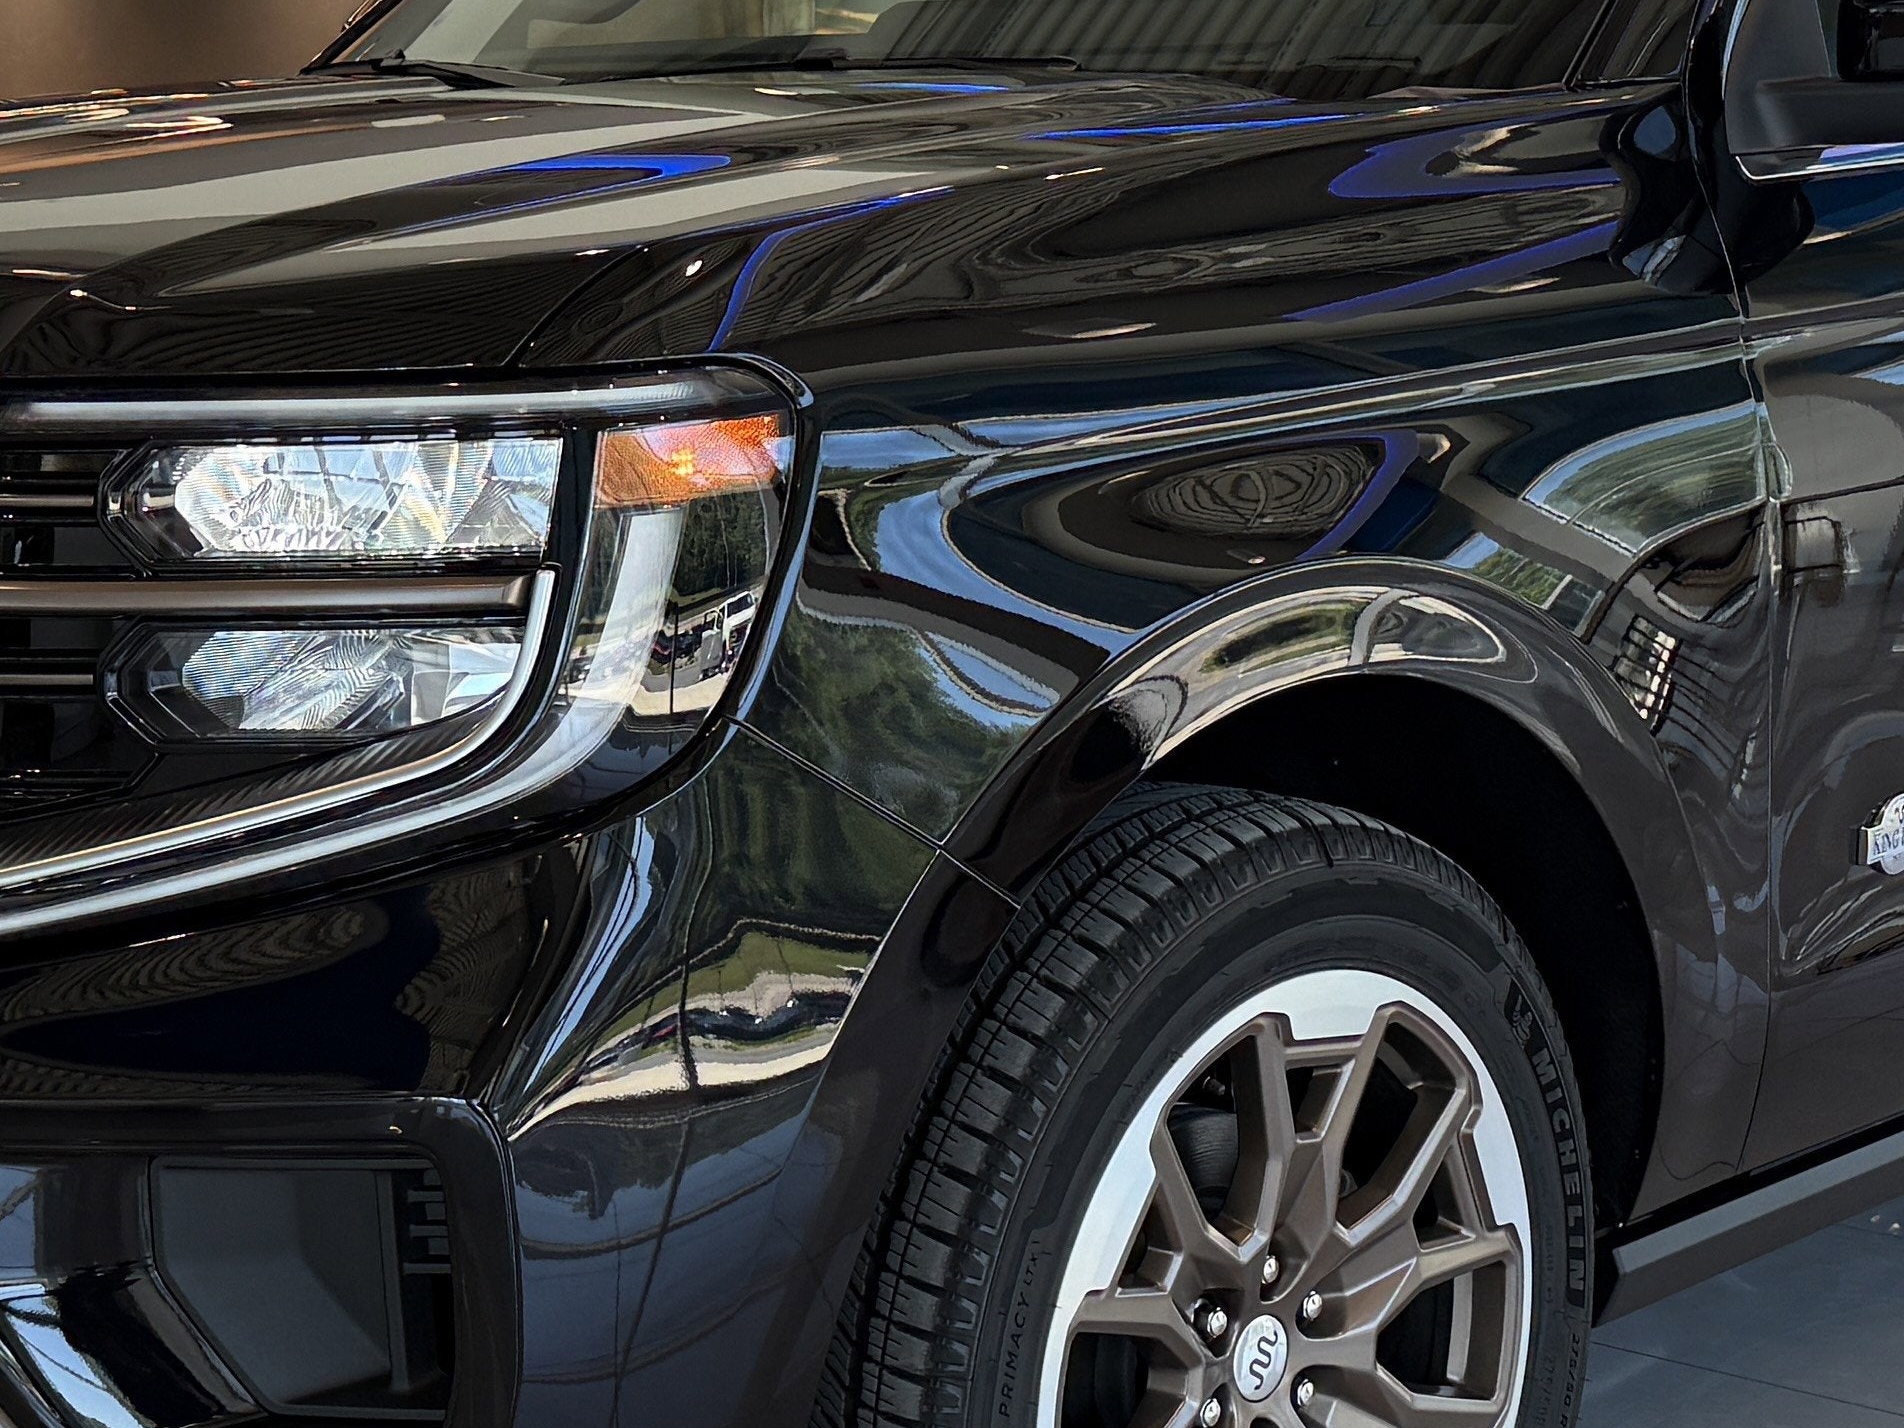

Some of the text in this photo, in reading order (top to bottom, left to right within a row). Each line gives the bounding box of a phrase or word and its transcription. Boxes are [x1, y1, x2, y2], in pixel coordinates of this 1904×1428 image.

[1531, 1046, 1585, 1292] MICHELIN
[998, 1254, 1039, 1419] PRIMACY LTX
